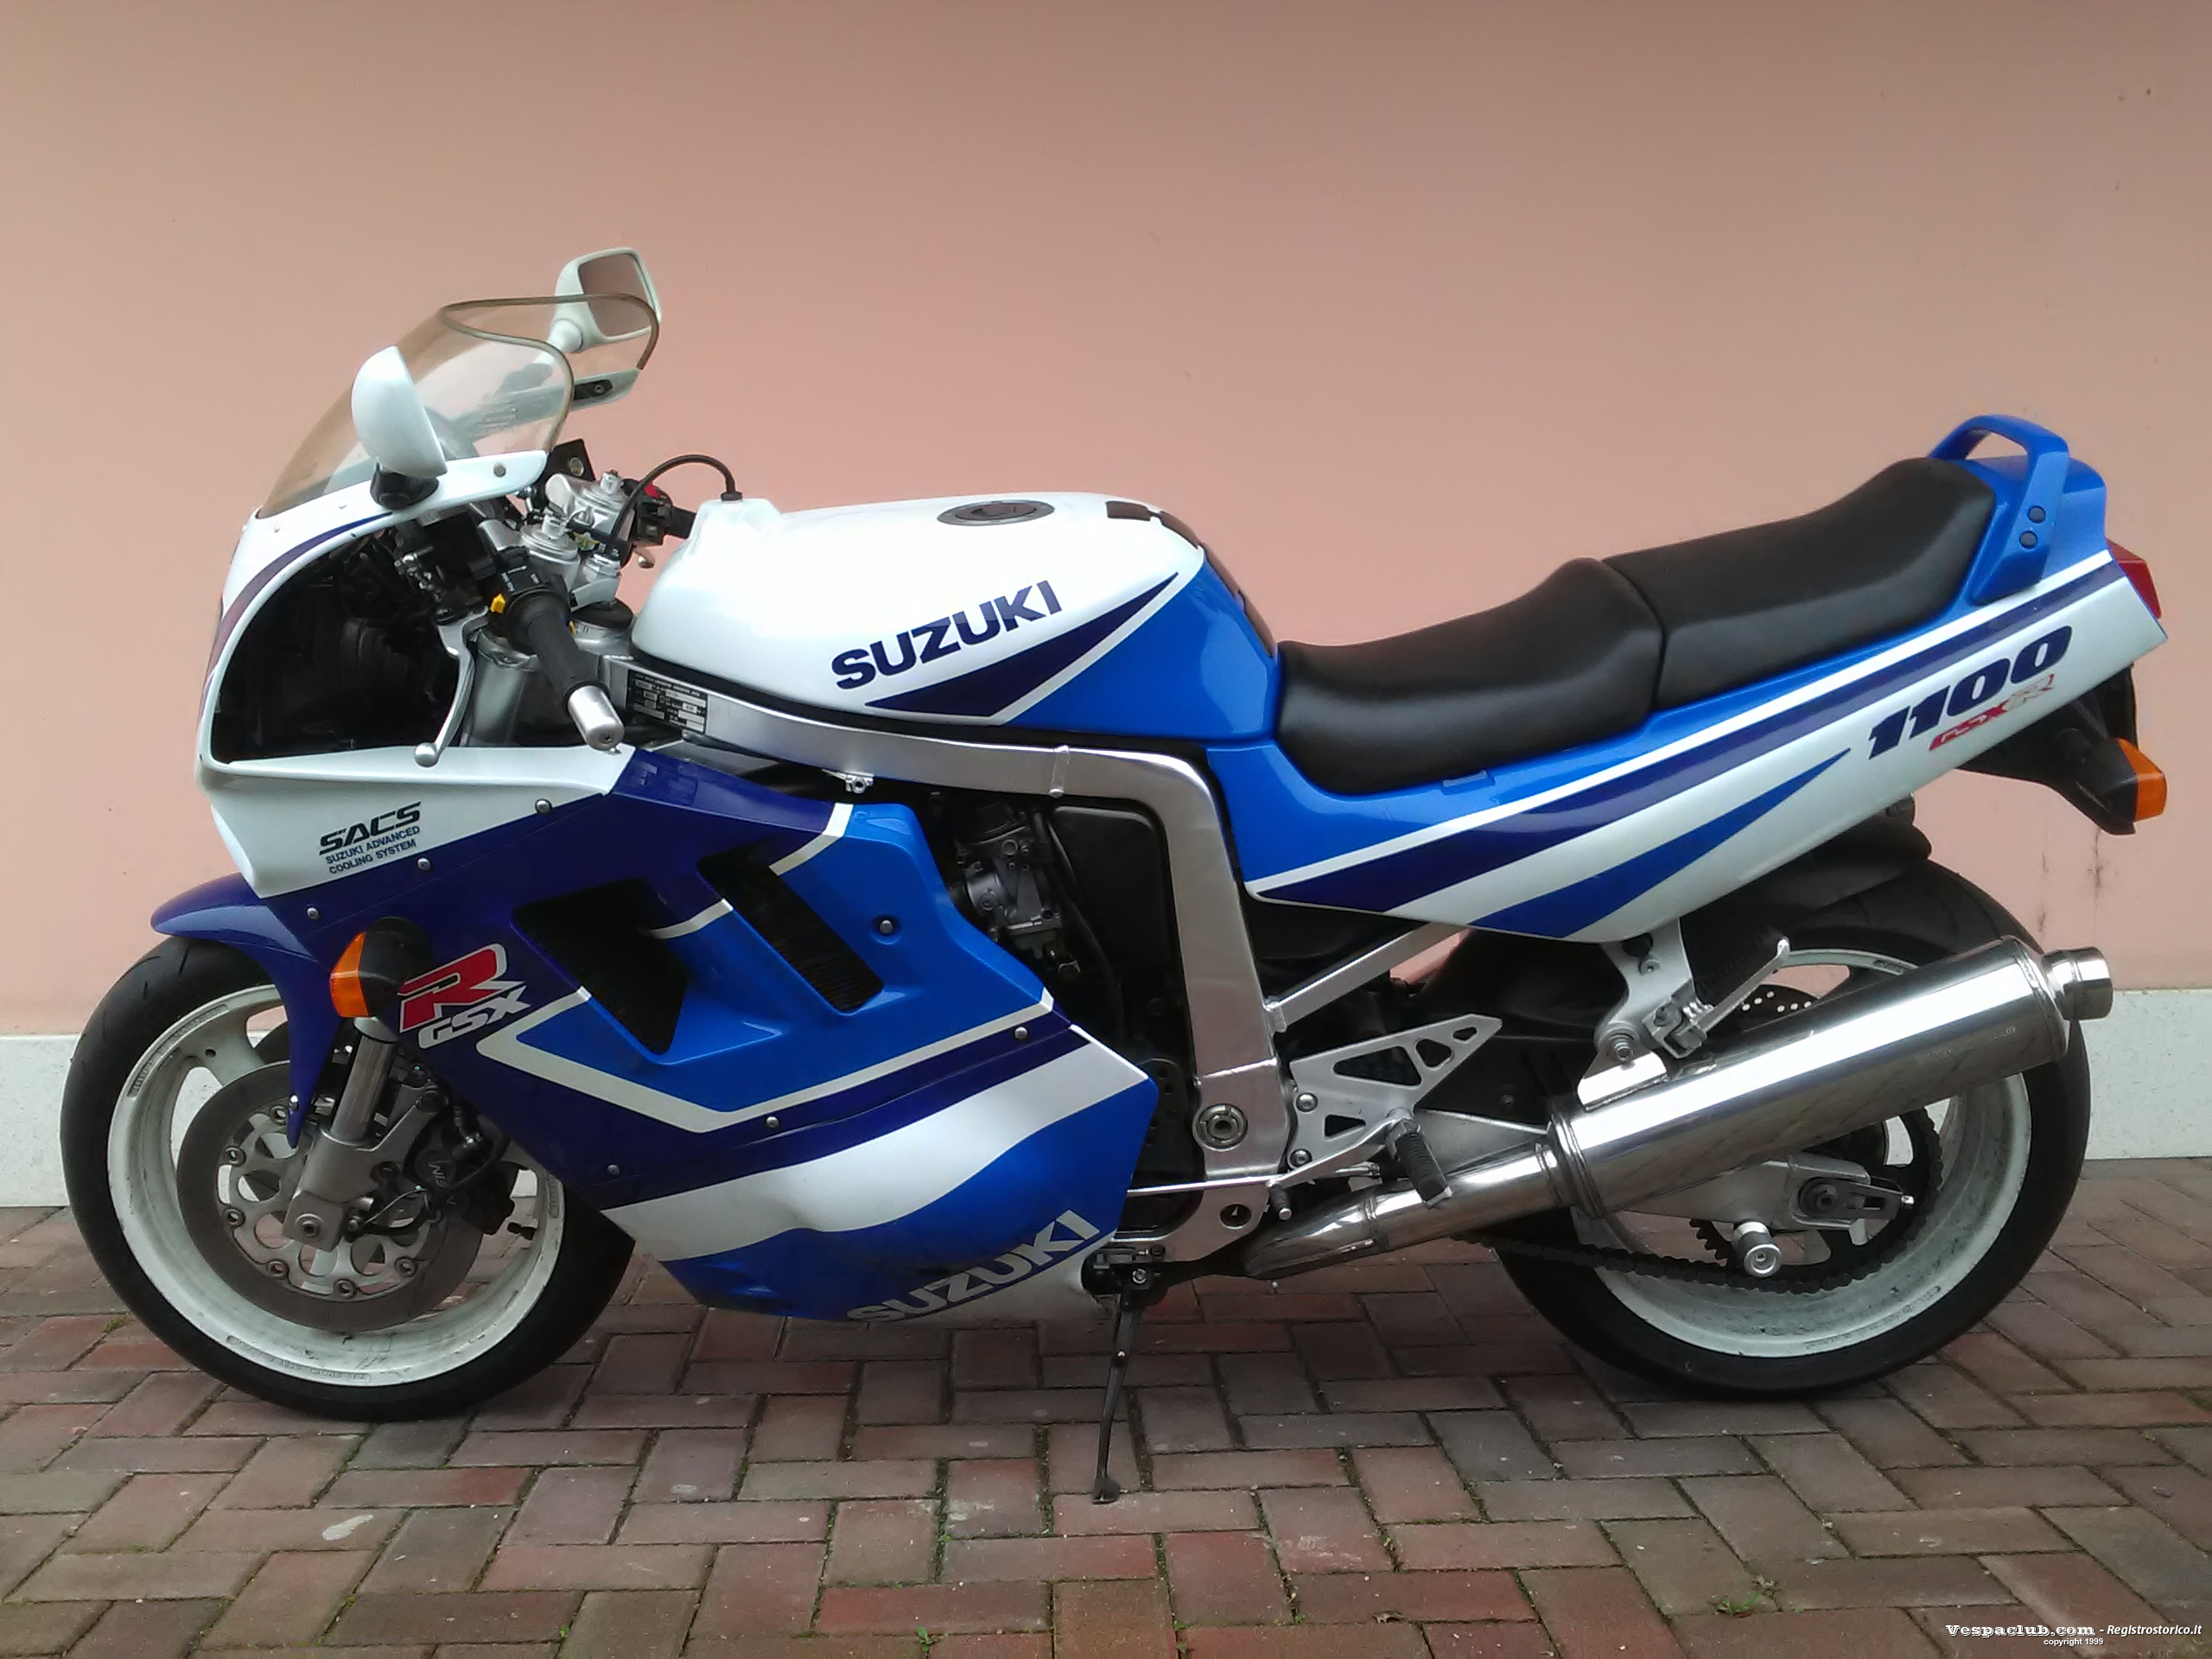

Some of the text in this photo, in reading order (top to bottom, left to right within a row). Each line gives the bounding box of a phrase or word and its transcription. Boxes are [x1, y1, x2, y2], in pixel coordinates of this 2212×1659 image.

[831, 580, 1062, 690] SUZUKI
[1868, 625, 2072, 760] 1100
[319, 801, 421, 855] SACS
[326, 825, 420, 864] SUZUKI ADVANCED
[329, 838, 416, 874] COOLING SYSTEM
[397, 943, 525, 1033] R
[418, 985, 531, 1049] GSX
[847, 1209, 1101, 1323] SUZUKI
